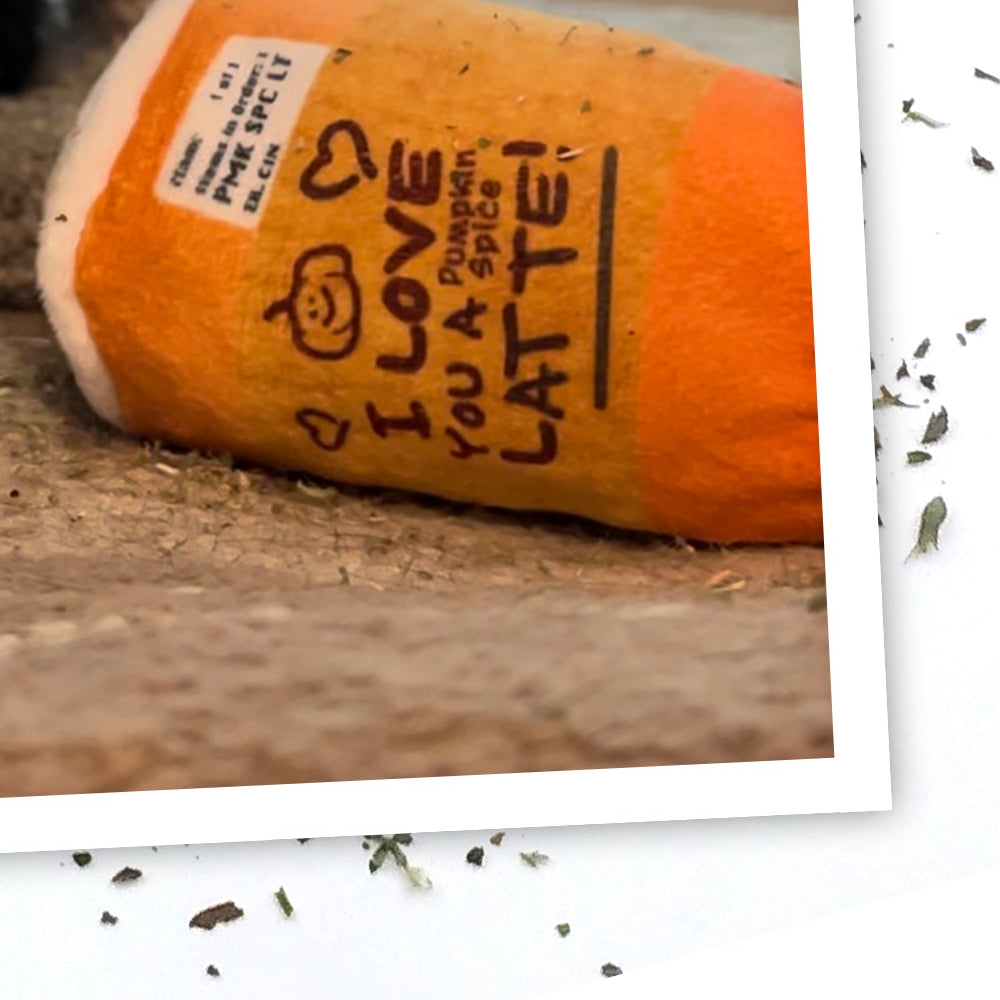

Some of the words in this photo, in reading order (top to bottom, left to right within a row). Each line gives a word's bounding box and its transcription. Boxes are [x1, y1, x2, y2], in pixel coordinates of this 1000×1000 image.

[212, 142, 255, 205] PMK
[244, 88, 279, 134] SPC
[266, 53, 292, 81] LT
[222, 120, 238, 136] in
[257, 143, 280, 180] CIN
[376, 139, 442, 373] LOVE
[442, 297, 487, 339] A
[365, 401, 430, 439] I
[445, 362, 489, 459] YOU
